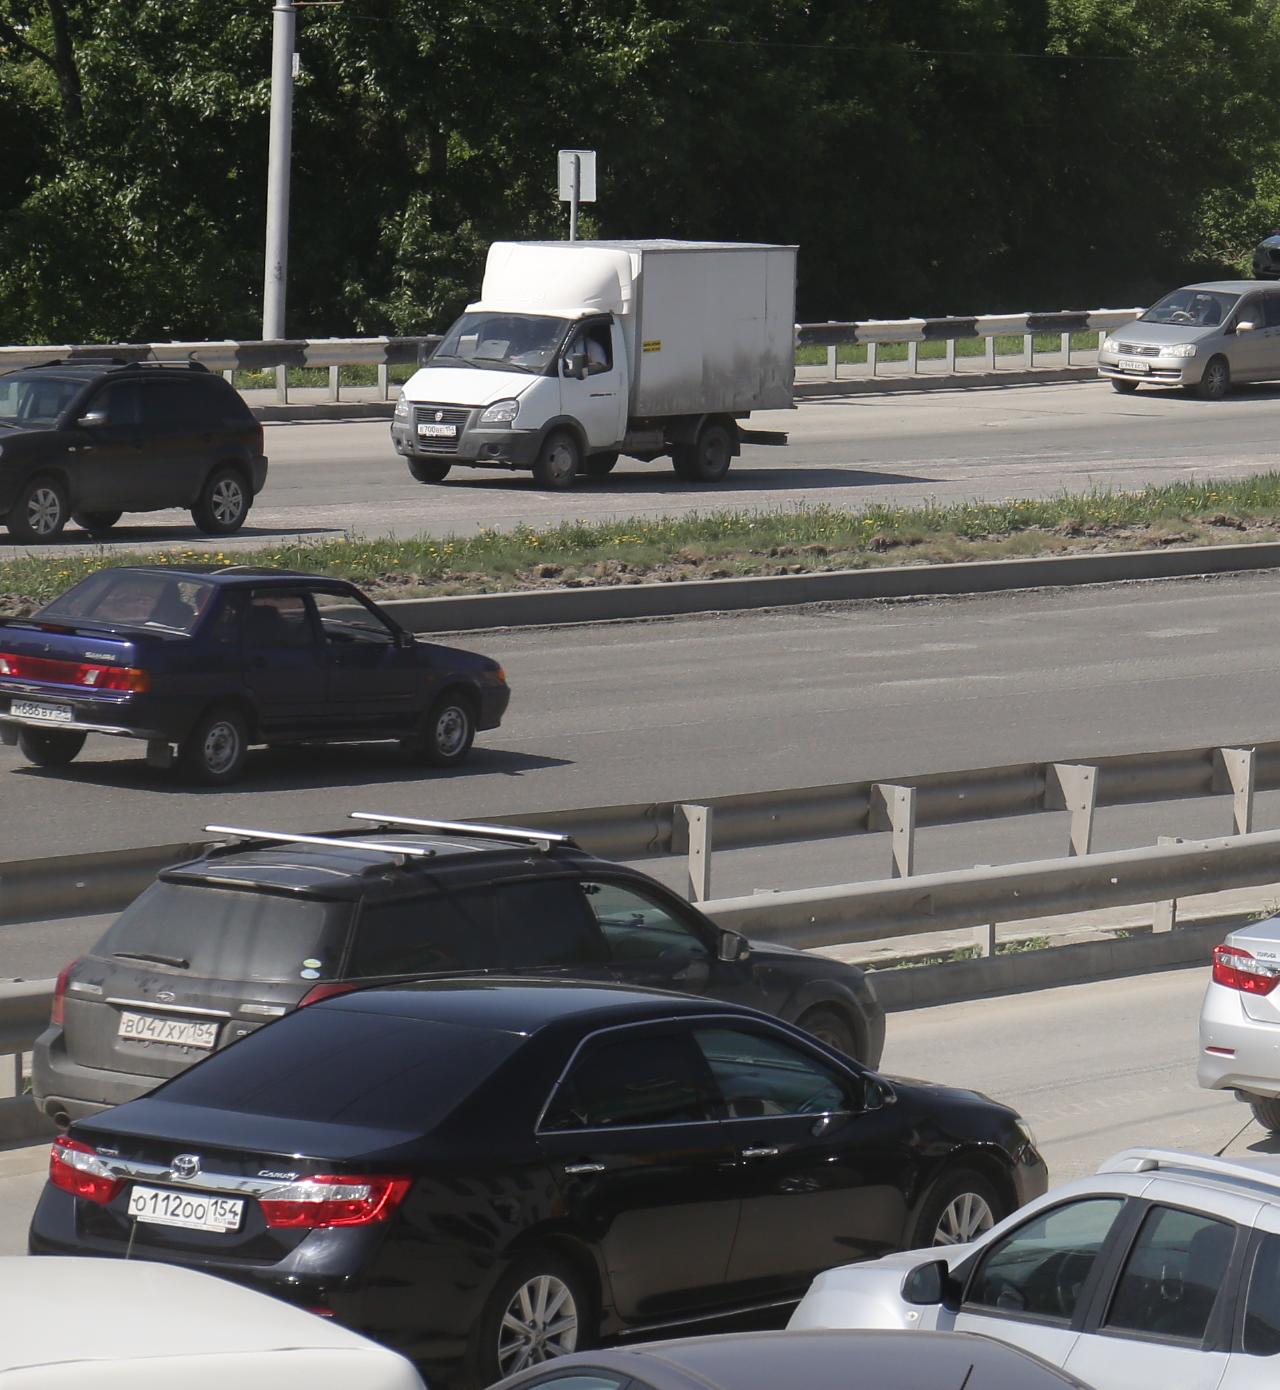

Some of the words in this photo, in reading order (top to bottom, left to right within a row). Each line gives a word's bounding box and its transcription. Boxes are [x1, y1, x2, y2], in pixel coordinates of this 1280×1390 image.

[125, 1018, 188, 1039] В047ХУ
[190, 1022, 214, 1038] 154
[135, 1192, 206, 1220] О112ОО
[210, 1199, 239, 1219] 154
